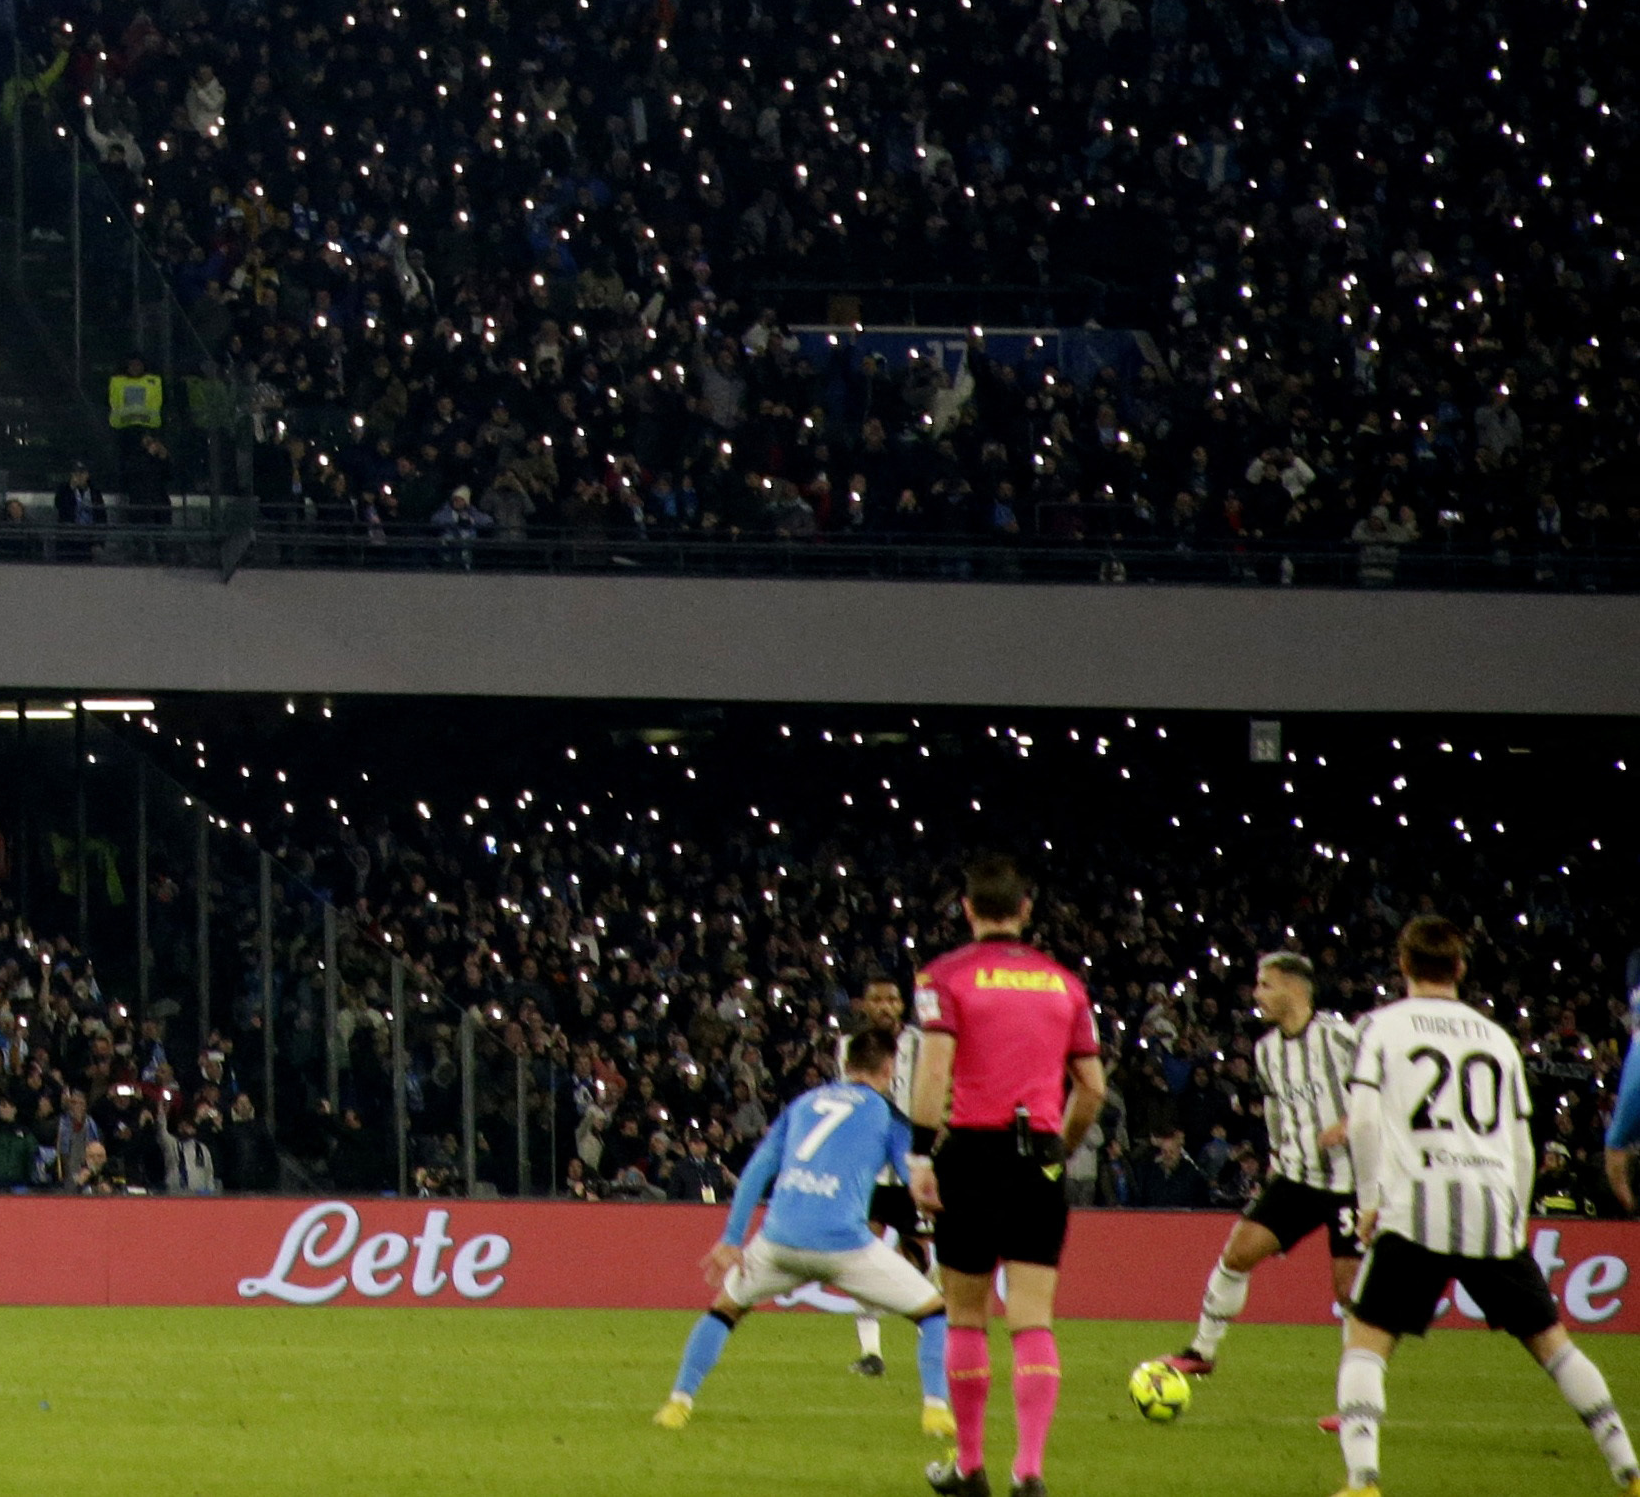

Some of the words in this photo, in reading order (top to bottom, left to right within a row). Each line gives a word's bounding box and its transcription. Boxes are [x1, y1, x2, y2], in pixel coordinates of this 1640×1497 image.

[1410, 1004, 1492, 1041] MIRETTI
[1406, 1045, 1503, 1136] 20
[794, 1097, 855, 1163] 7
[236, 1201, 512, 1305] Lete
